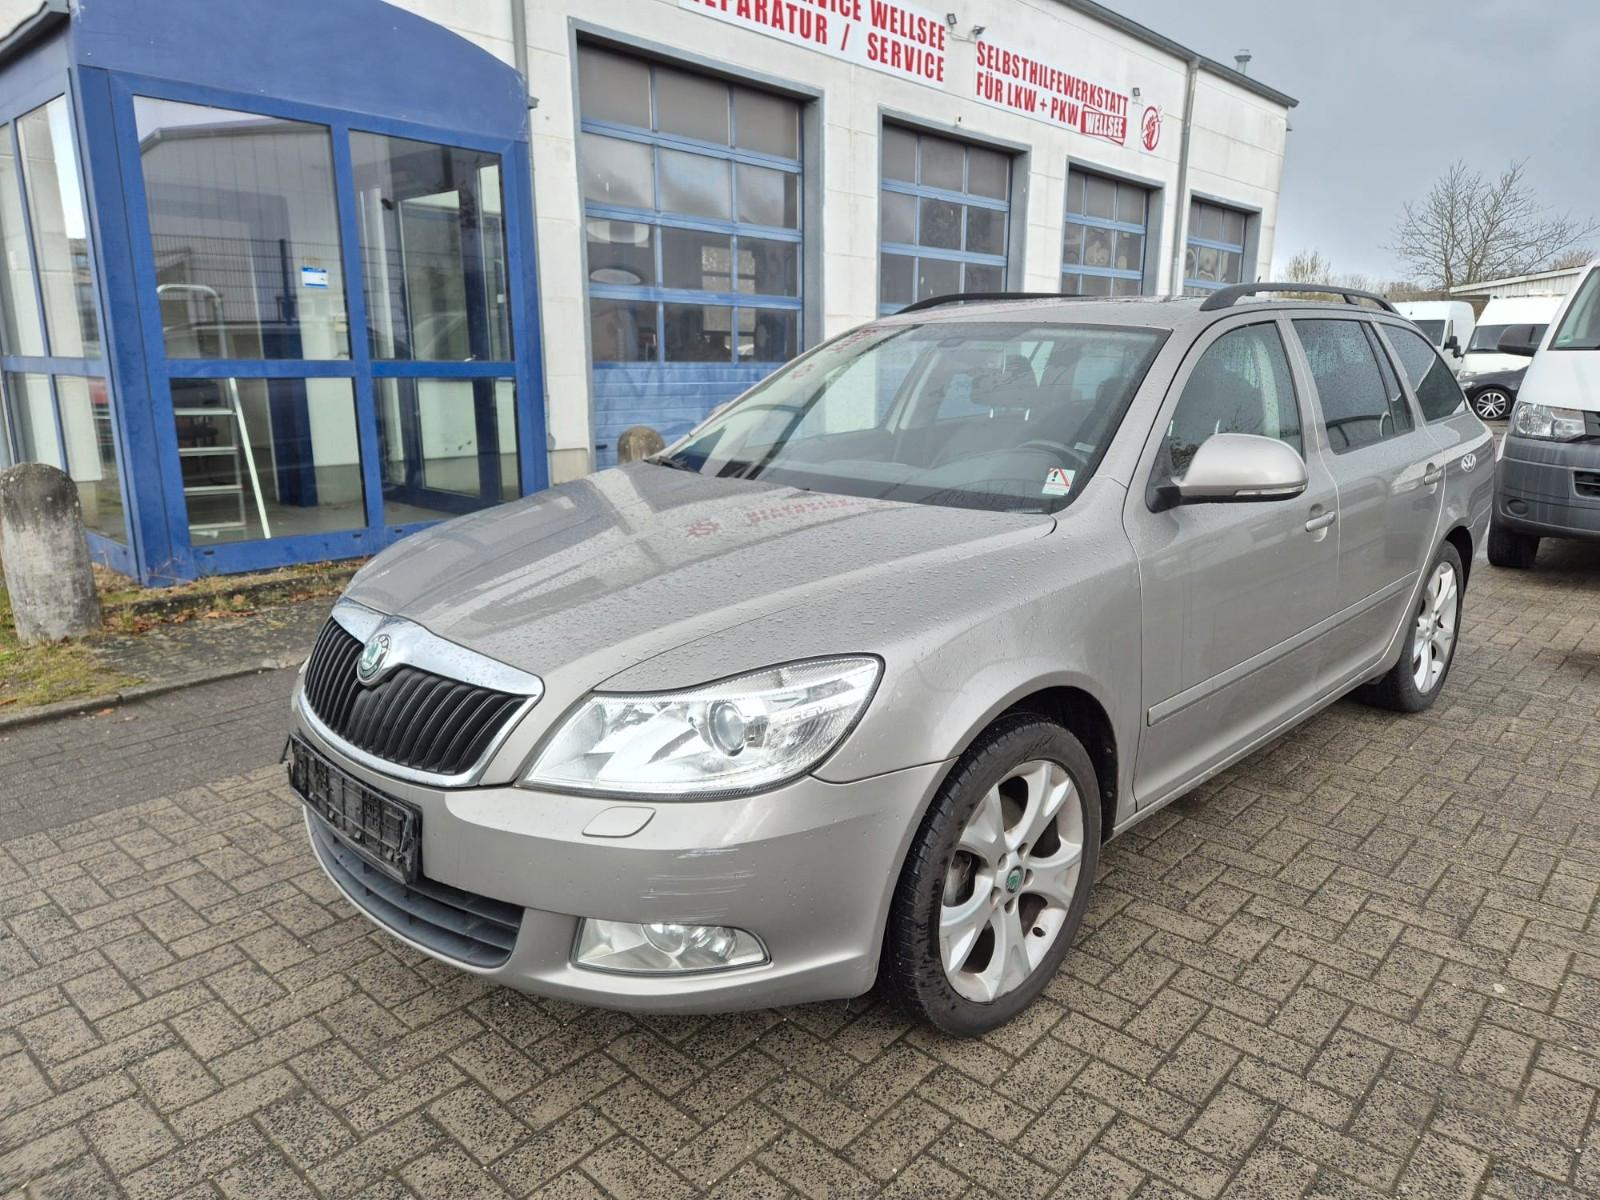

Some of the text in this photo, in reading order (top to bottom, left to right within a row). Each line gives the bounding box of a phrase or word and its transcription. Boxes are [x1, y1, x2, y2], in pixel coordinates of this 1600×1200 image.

[841, 23, 850, 51] /
[867, 32, 945, 82] SERVICE
[870, 0, 945, 51] WELLSEE
[976, 71, 1079, 127] FÜR LKW + PKW
[977, 40, 1128, 115] SELBSTHILFEWERKSTATT
[1086, 111, 1123, 137] WELLSEE
